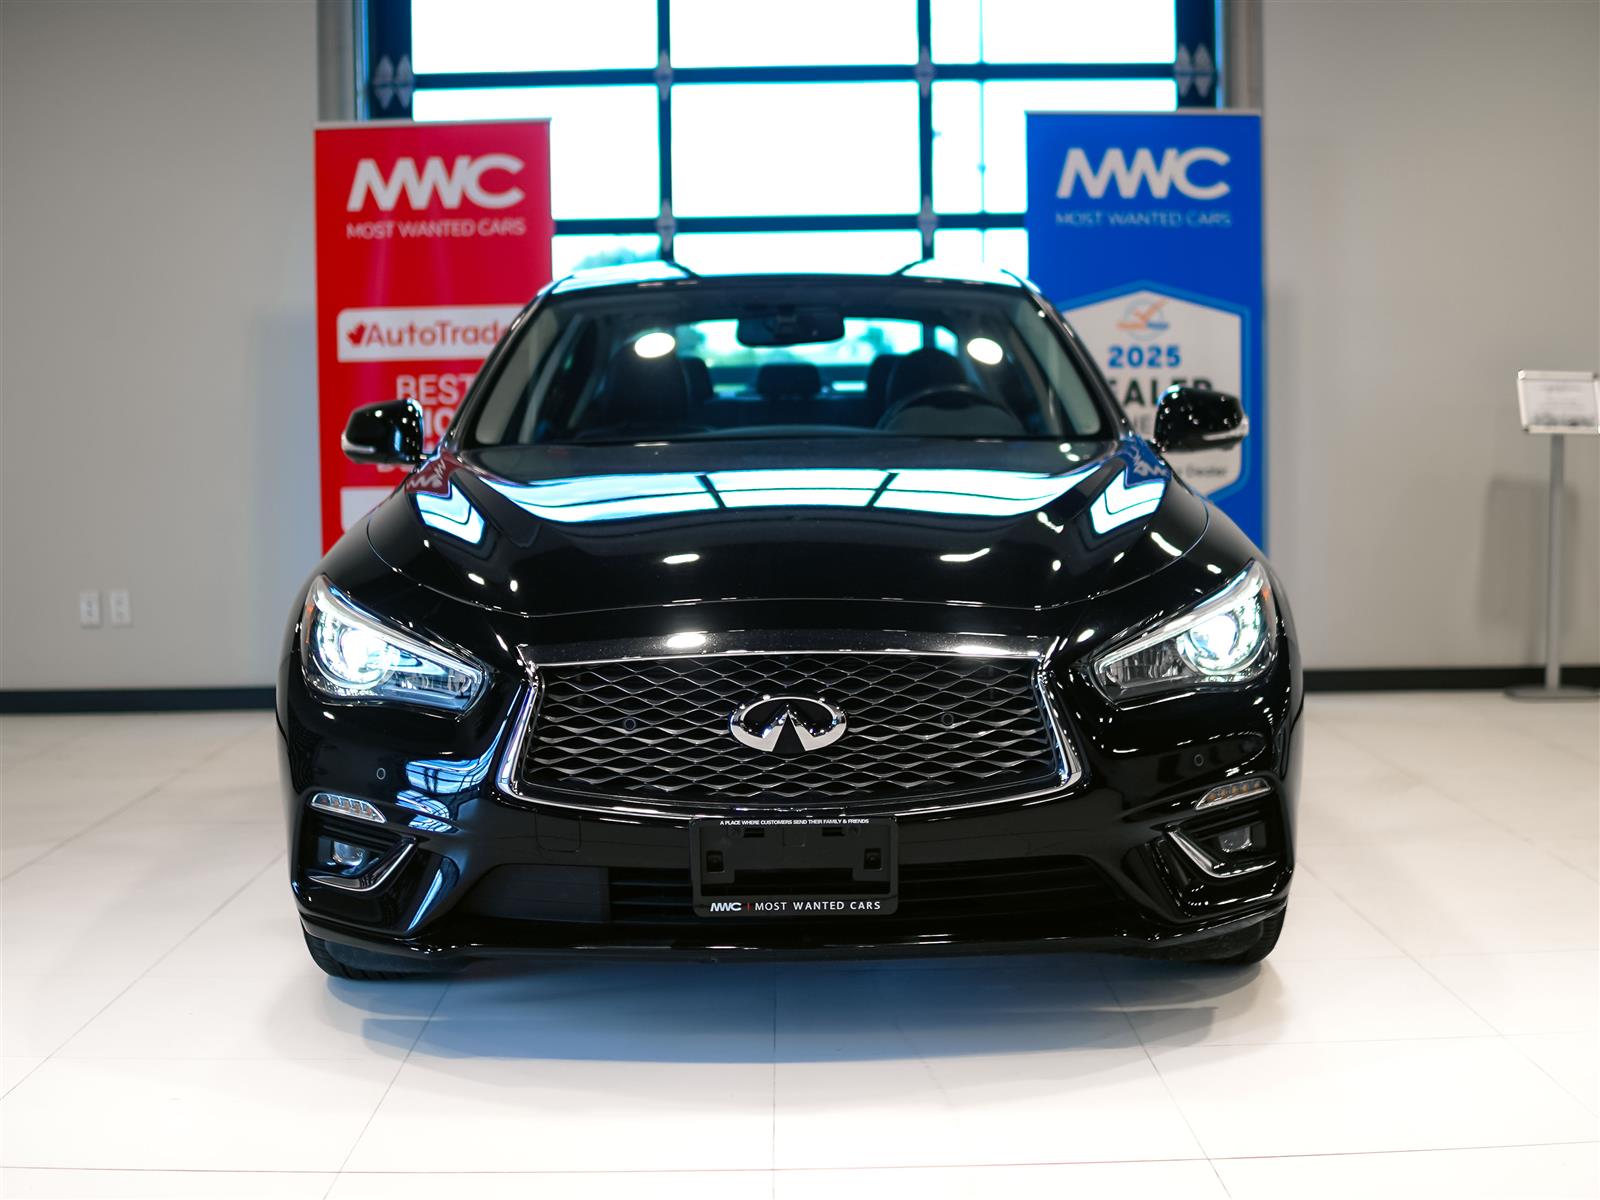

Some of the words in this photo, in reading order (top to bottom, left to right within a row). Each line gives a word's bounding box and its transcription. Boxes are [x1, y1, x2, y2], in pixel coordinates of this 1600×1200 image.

[347, 153, 525, 212] MWC
[1056, 147, 1231, 200] MWC
[347, 221, 394, 239] MOST
[401, 219, 475, 238] WANTED
[477, 218, 526, 236] CARS
[1055, 211, 1102, 227] MOST
[1109, 211, 1180, 227] WANTED
[1186, 211, 1231, 227] CARS
[1108, 346, 1182, 368] 2025
[710, 902, 742, 912] MWC
[754, 902, 788, 911] MOST
[793, 901, 845, 911] WANTED
[849, 901, 881, 910] CARS
